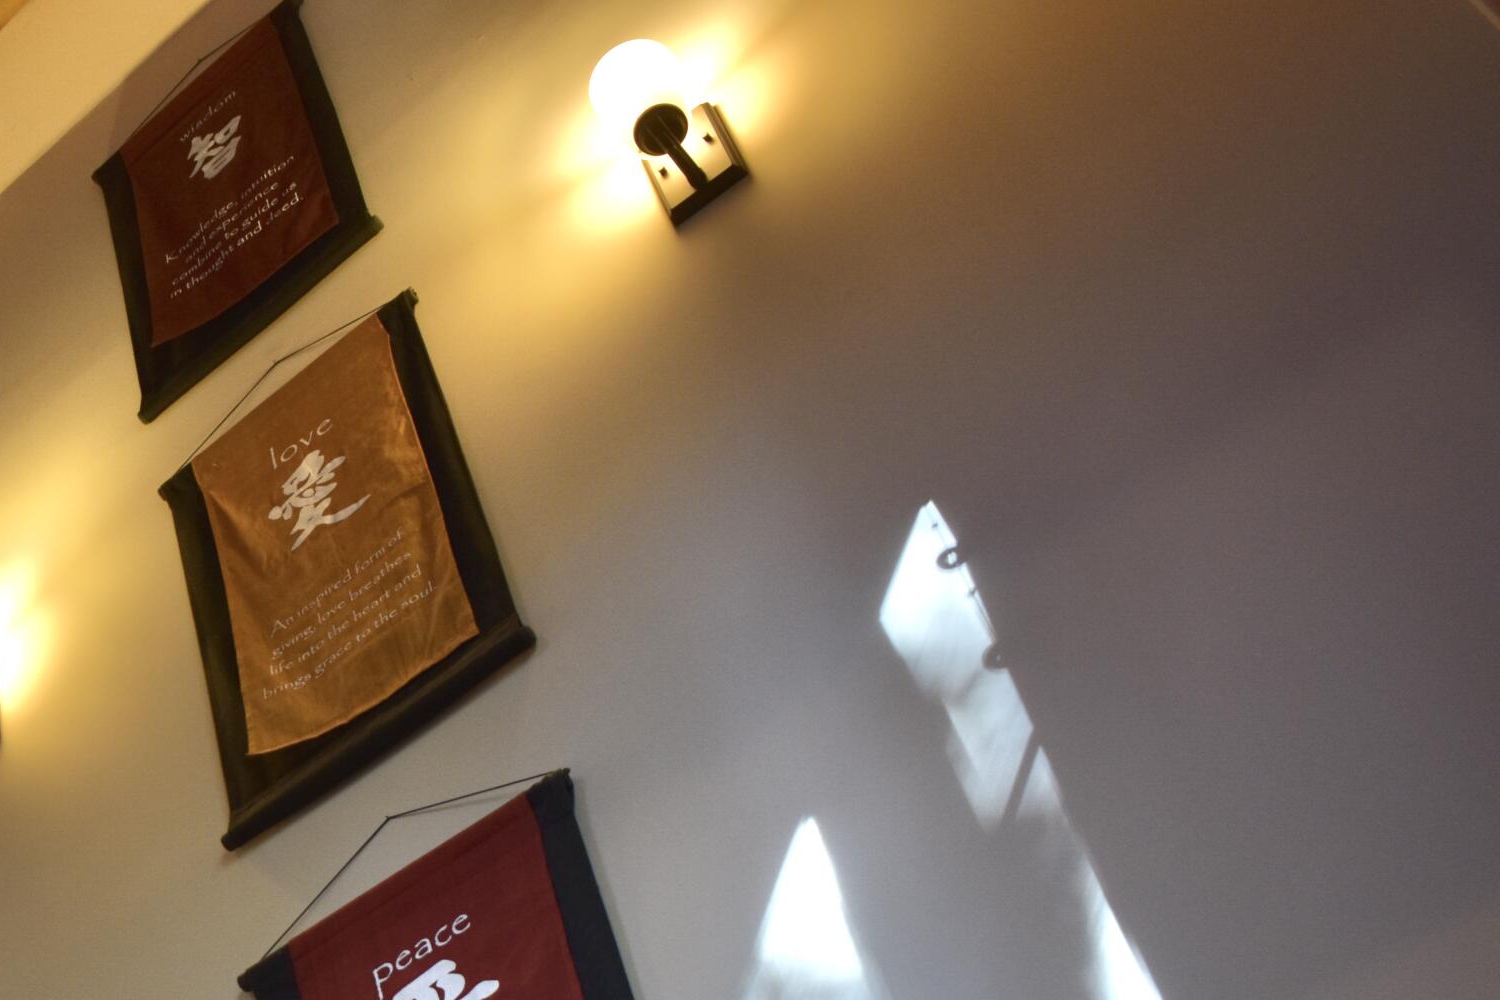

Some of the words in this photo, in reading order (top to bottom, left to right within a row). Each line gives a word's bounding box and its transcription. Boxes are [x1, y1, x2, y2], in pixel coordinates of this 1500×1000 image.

[180, 90, 236, 142] wisdom
[165, 201, 238, 264] Knowledge,
[241, 156, 294, 200] intuition
[170, 289, 182, 299] in
[186, 245, 234, 289] thought
[237, 220, 262, 246] and
[266, 192, 303, 225] deed.
[172, 242, 221, 286] combine
[224, 227, 239, 240] to
[242, 198, 278, 231] guide
[186, 236, 206, 263] and
[209, 182, 278, 239] experience
[270, 418, 333, 469] love
[268, 449, 371, 551] 愛
[269, 660, 293, 676] life
[298, 640, 324, 663] into
[327, 620, 349, 640] the
[352, 589, 391, 622] heart
[394, 563, 422, 592] and
[271, 616, 294, 638] An
[298, 568, 352, 617] inspired
[354, 546, 385, 574] form
[388, 526, 405, 548] of
[272, 624, 316, 660] giving,
[317, 600, 345, 624] love
[348, 552, 411, 601] breathes
[263, 673, 312, 699] brings
[314, 641, 351, 679] grace
[355, 628, 371, 643] to
[373, 608, 398, 628] the
[401, 580, 436, 609] soul.
[372, 913, 471, 1000] peace
